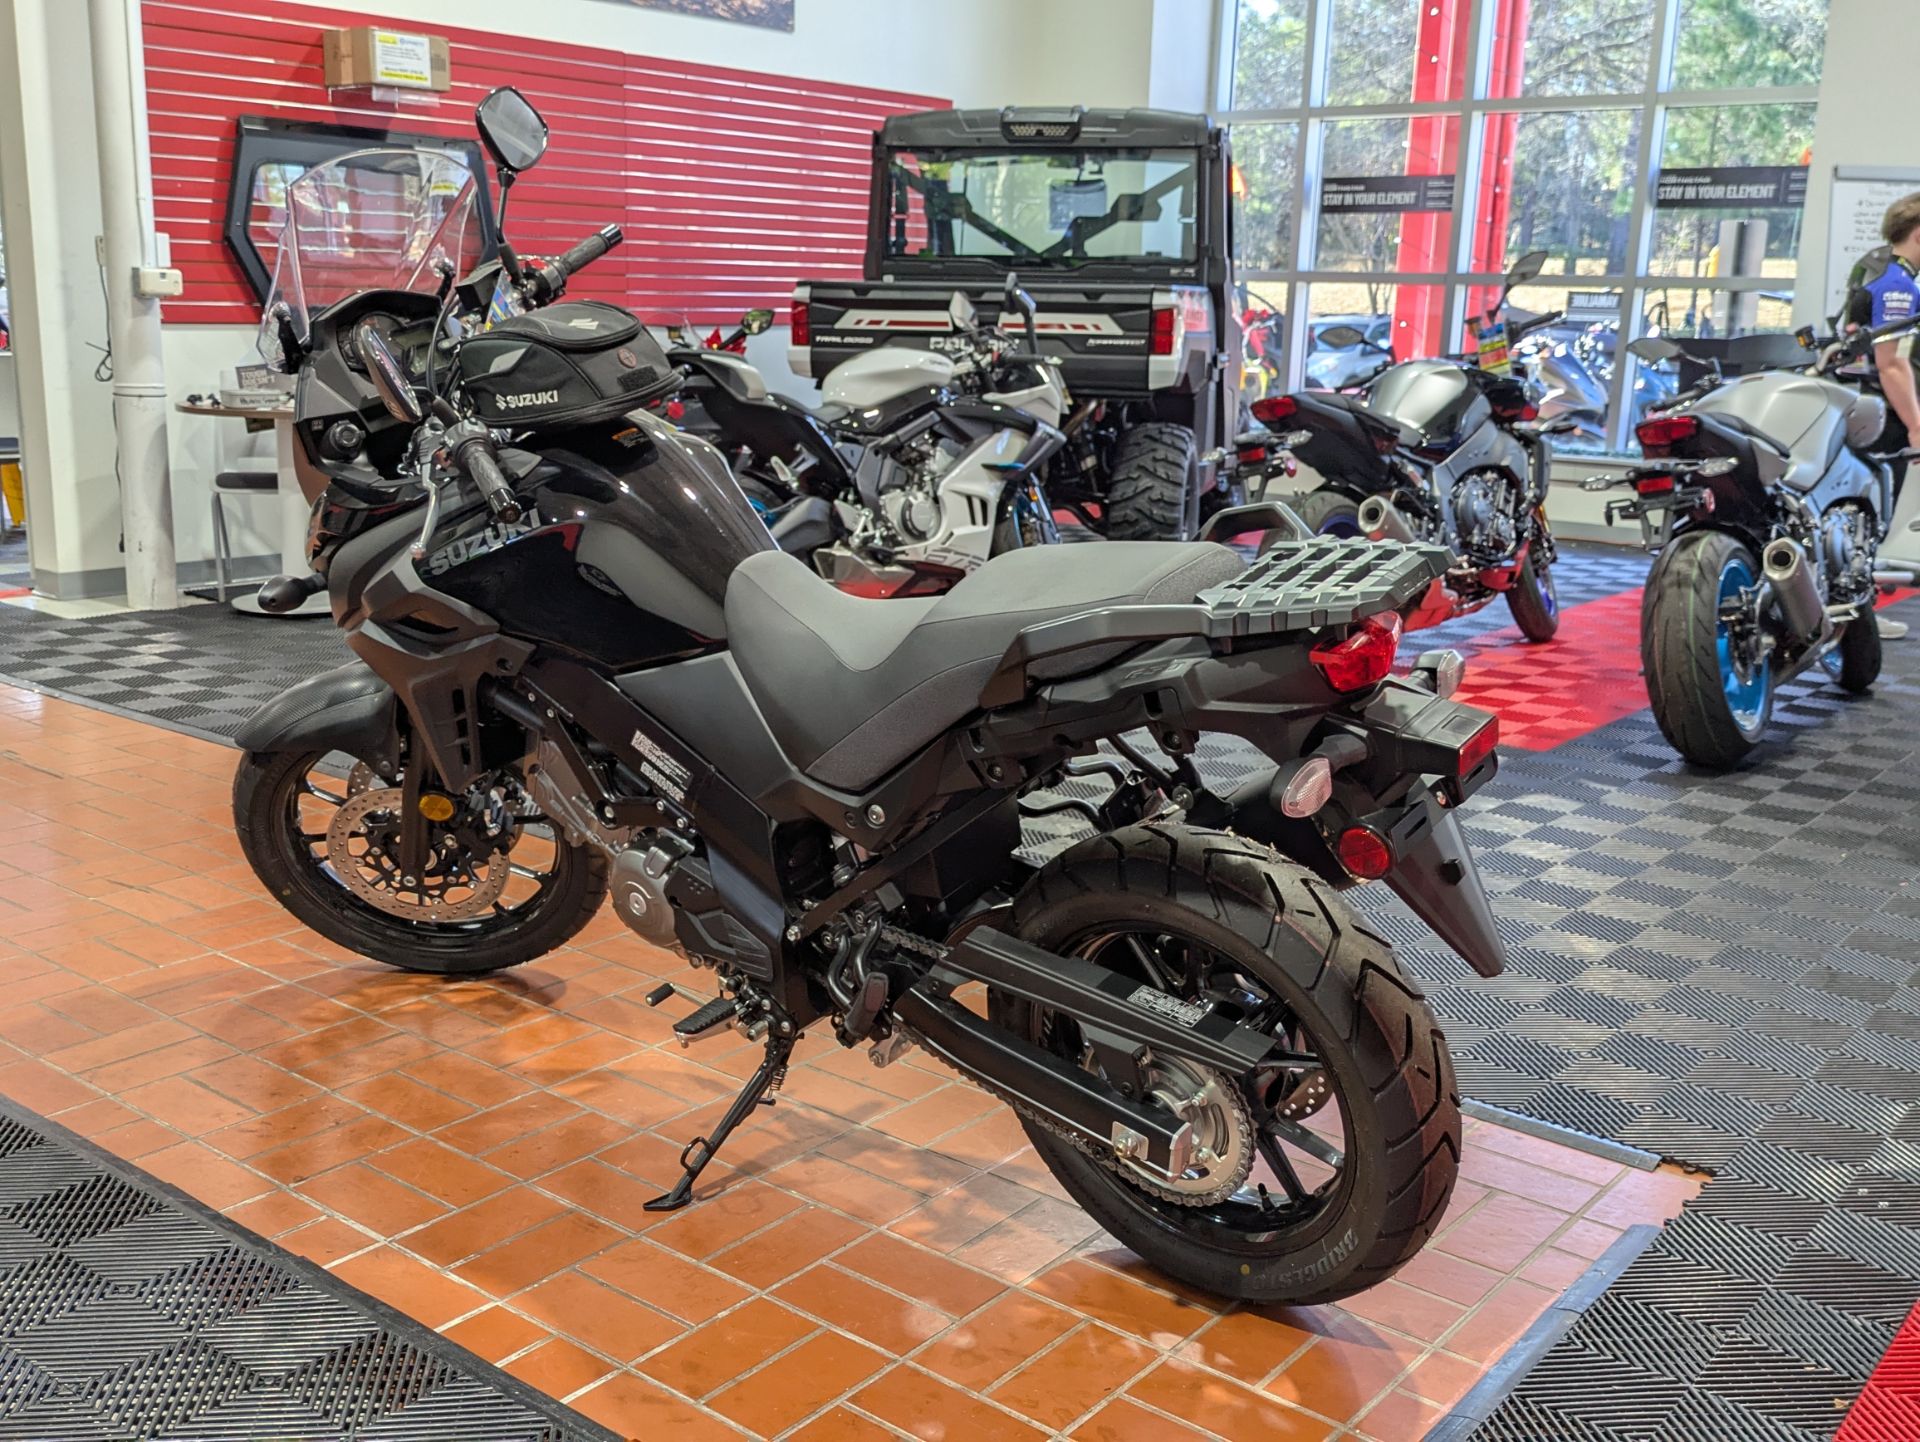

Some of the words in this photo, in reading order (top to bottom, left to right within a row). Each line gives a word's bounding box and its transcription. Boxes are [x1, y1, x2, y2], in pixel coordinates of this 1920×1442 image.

[1323, 193, 1343, 206] STAY
[1344, 193, 1354, 205] IN
[1355, 192, 1376, 205] YOUR
[1377, 191, 1417, 205] ELEMENT
[1658, 186, 1683, 199] STAY
[1684, 186, 1697, 199] IN
[1698, 185, 1725, 198] YOUR
[1726, 184, 1776, 198] ELEMENT
[507, 390, 559, 408] SUZUKI
